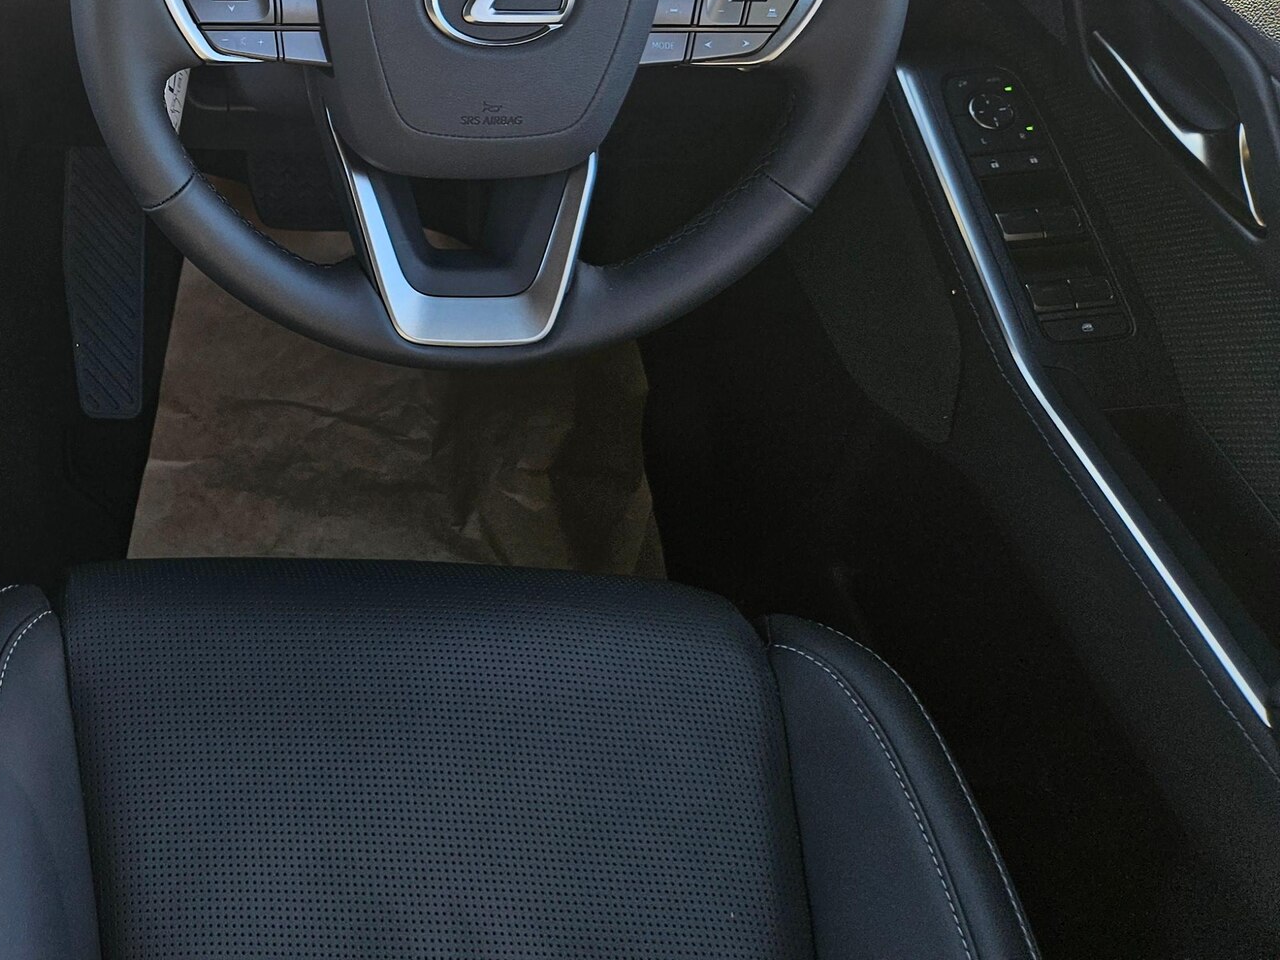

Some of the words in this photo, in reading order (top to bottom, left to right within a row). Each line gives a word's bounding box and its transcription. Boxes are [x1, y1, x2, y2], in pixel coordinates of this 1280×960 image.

[652, 41, 675, 50] MODE
[460, 116, 481, 125] SRS
[482, 116, 523, 126] AIRBAG
